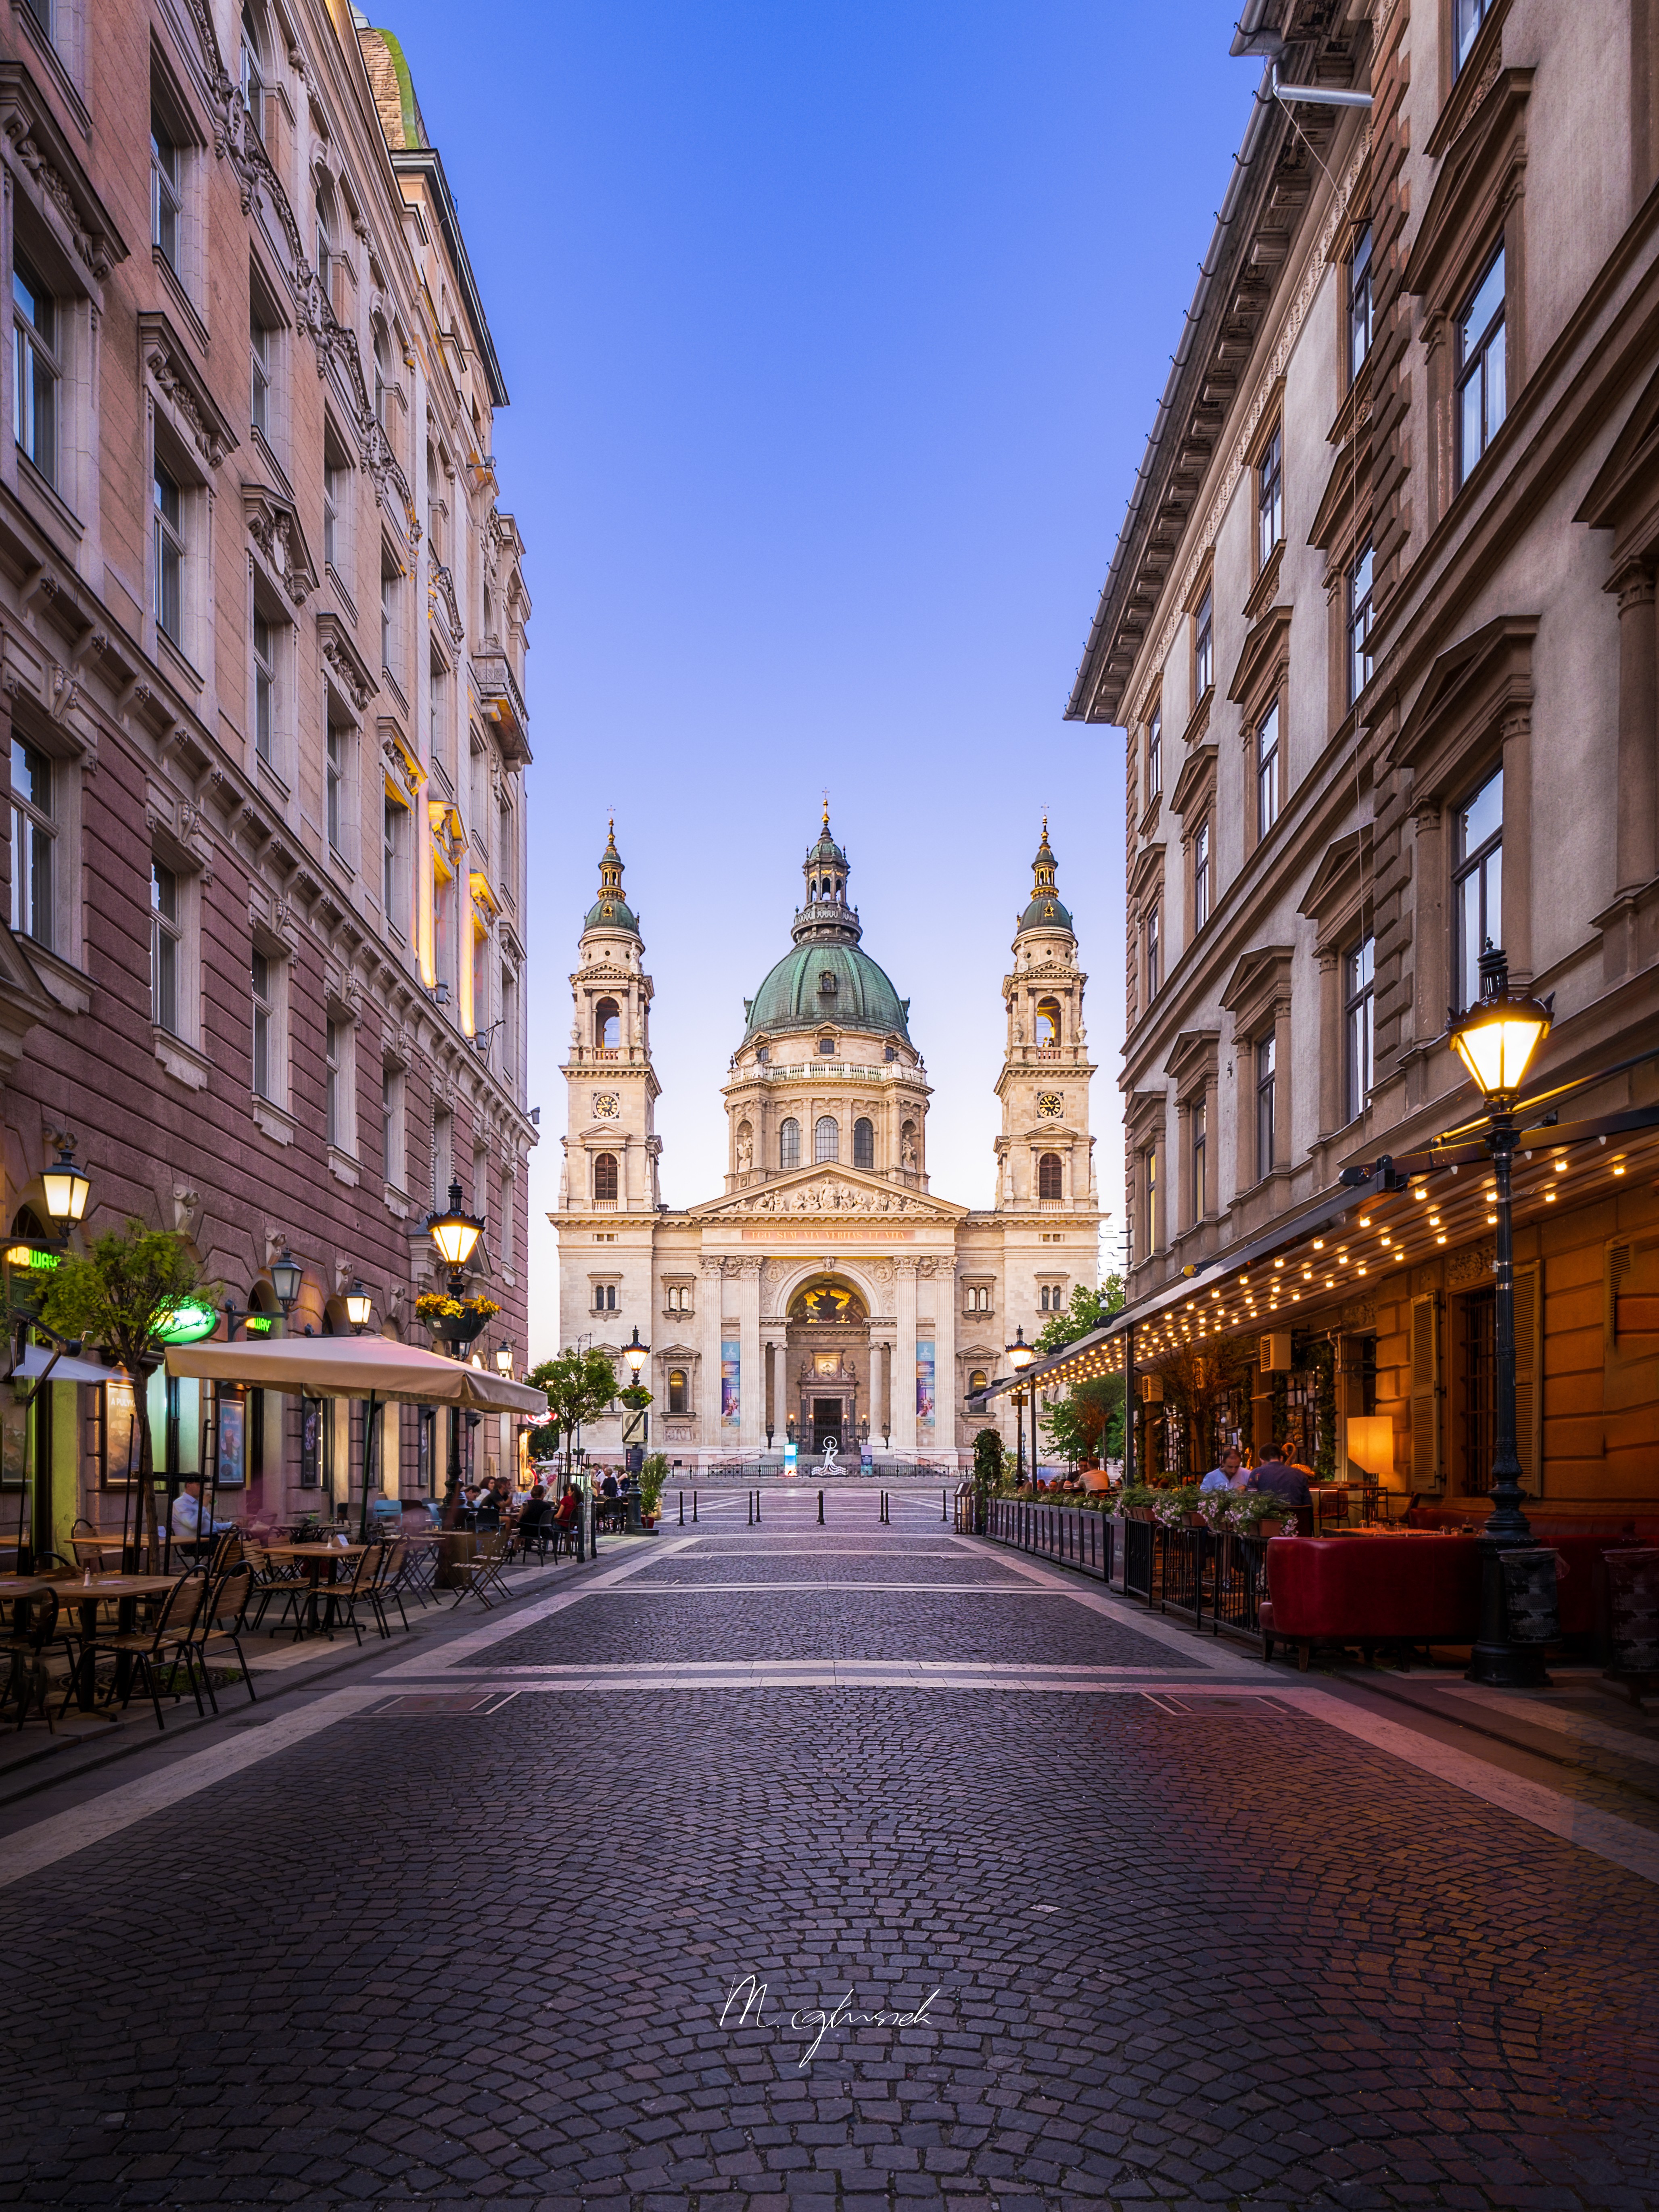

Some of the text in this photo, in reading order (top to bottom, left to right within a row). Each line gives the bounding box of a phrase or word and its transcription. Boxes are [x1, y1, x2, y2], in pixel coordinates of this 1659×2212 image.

[885, 1232, 905, 1240] VITA
[246, 1317, 272, 1332] WAY
[111, 1397, 116, 1406] A
